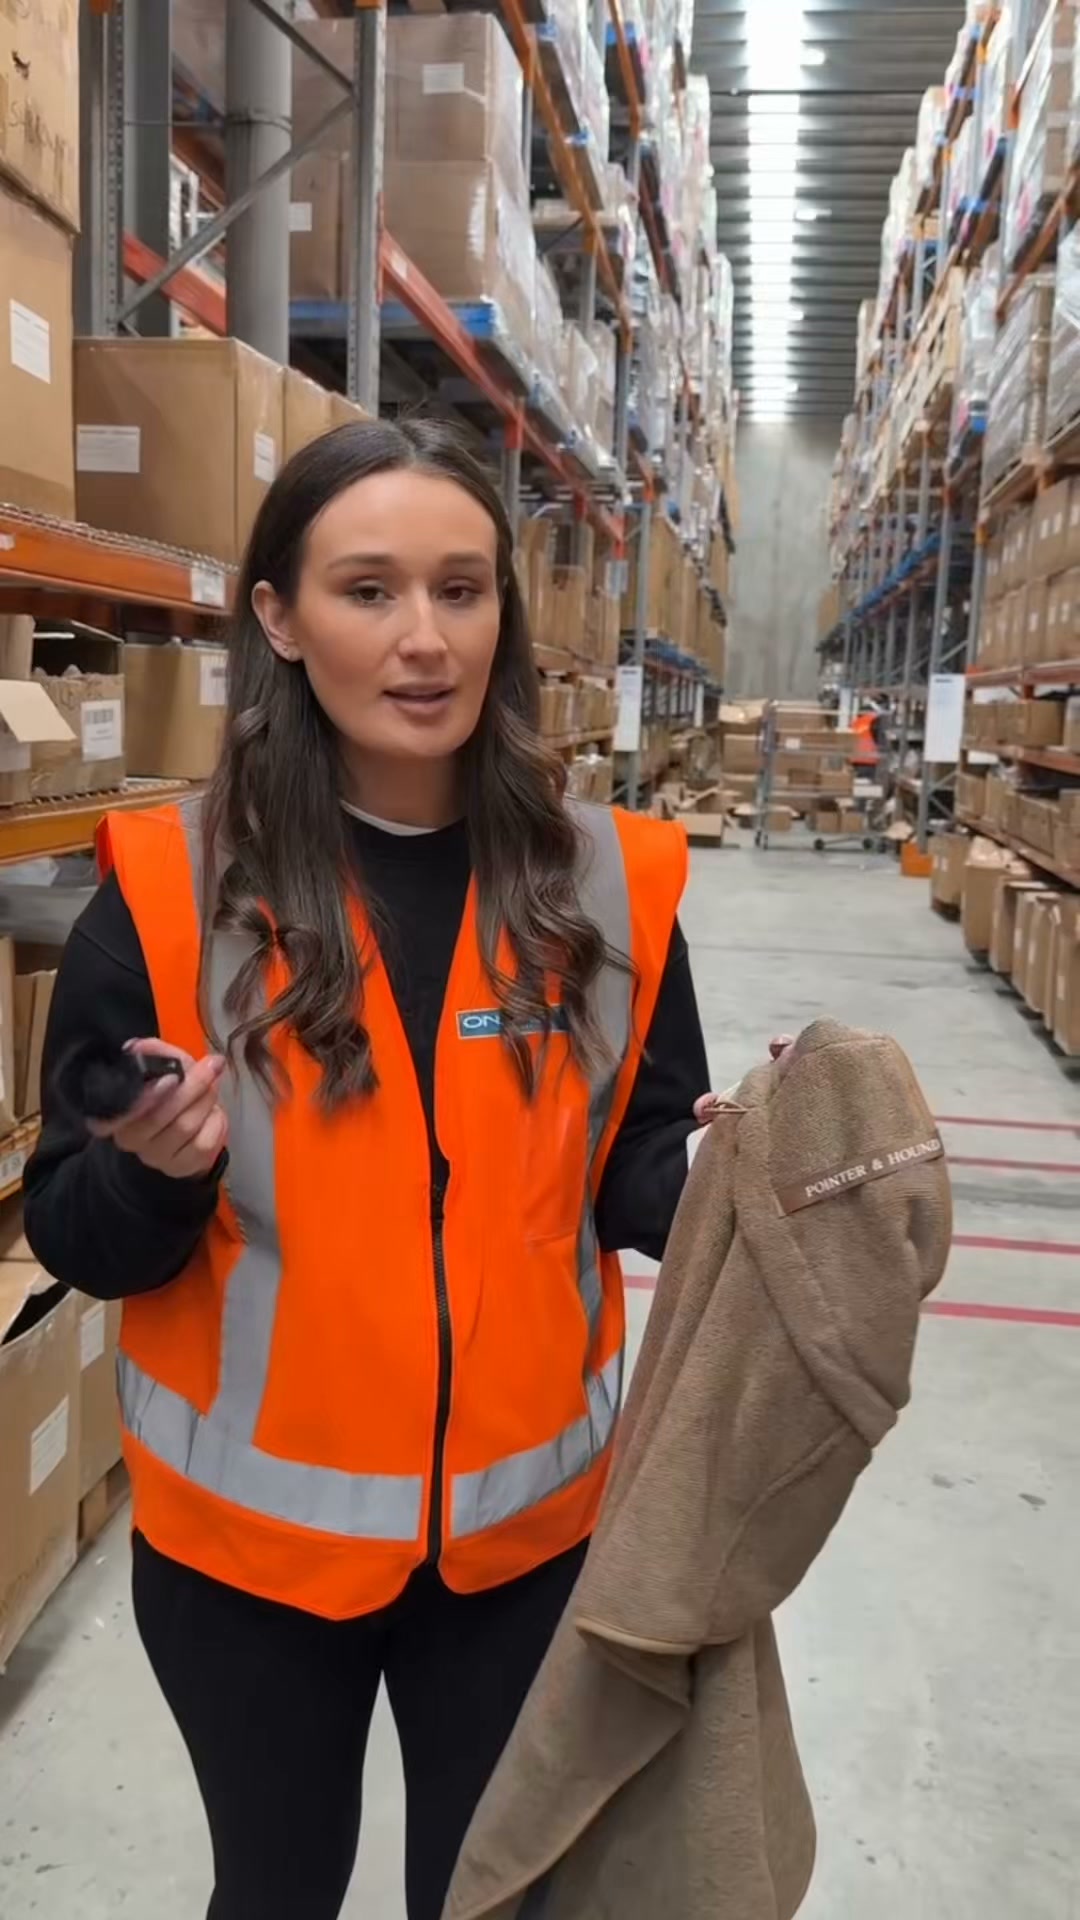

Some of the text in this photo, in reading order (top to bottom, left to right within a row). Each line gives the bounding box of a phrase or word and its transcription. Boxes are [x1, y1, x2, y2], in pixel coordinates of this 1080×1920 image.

[804, 1138, 941, 1198] POINTER & HOUND
